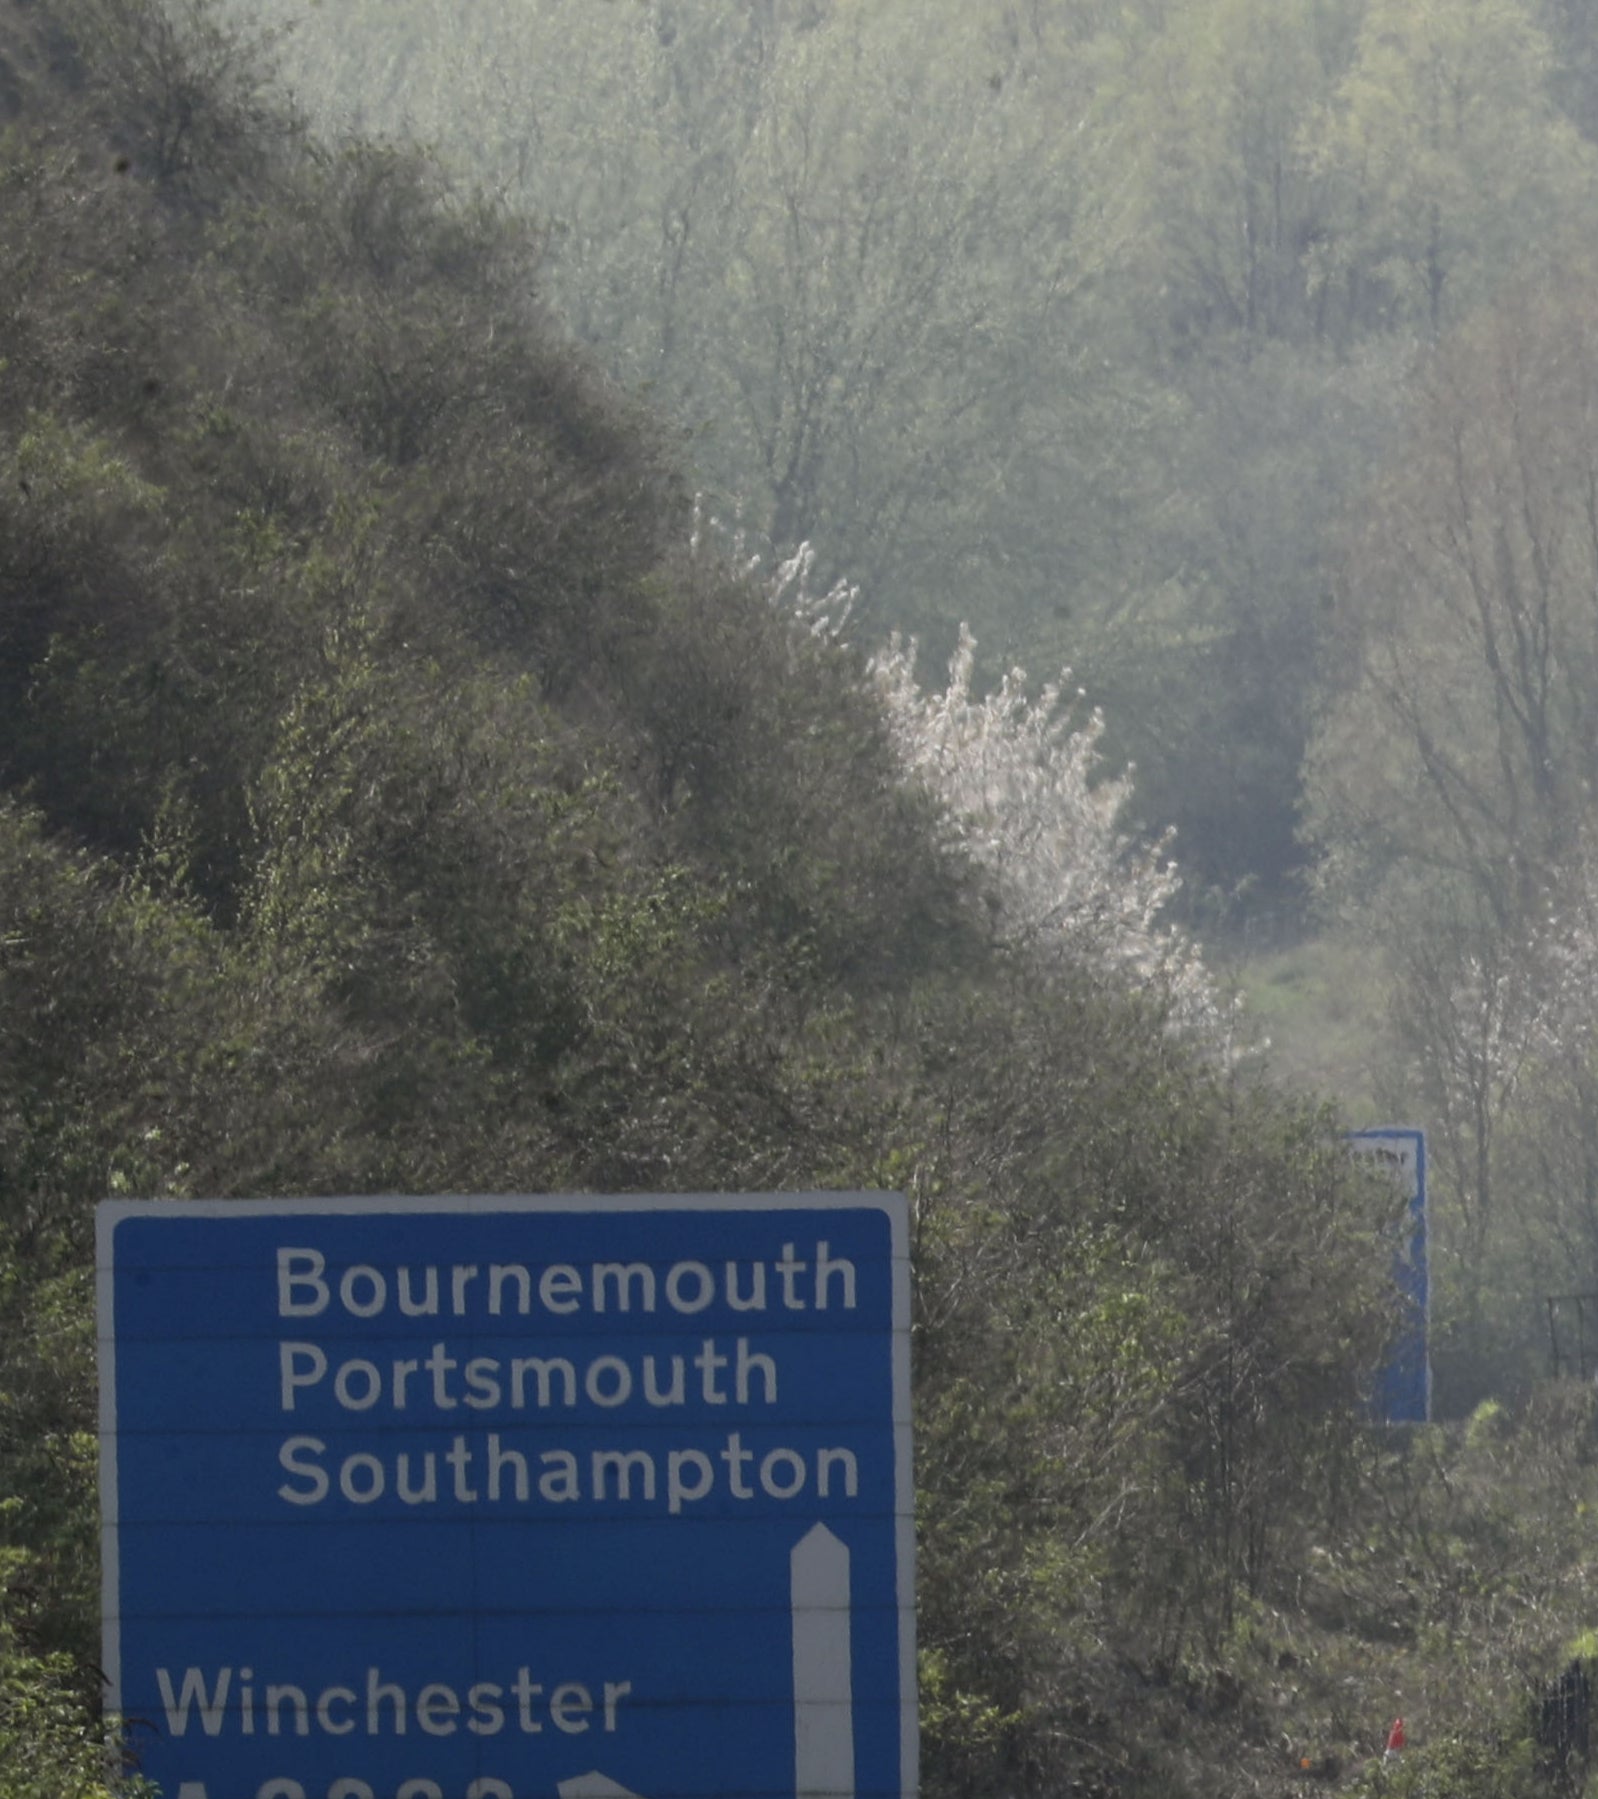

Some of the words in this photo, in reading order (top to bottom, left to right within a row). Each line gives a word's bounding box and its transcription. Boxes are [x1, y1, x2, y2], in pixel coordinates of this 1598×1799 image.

[277, 1242, 857, 1318] Bournemouth
[280, 1338, 778, 1411] Portsmouth
[277, 1431, 858, 1513] Southampton
[156, 1666, 632, 1737] Winchester
